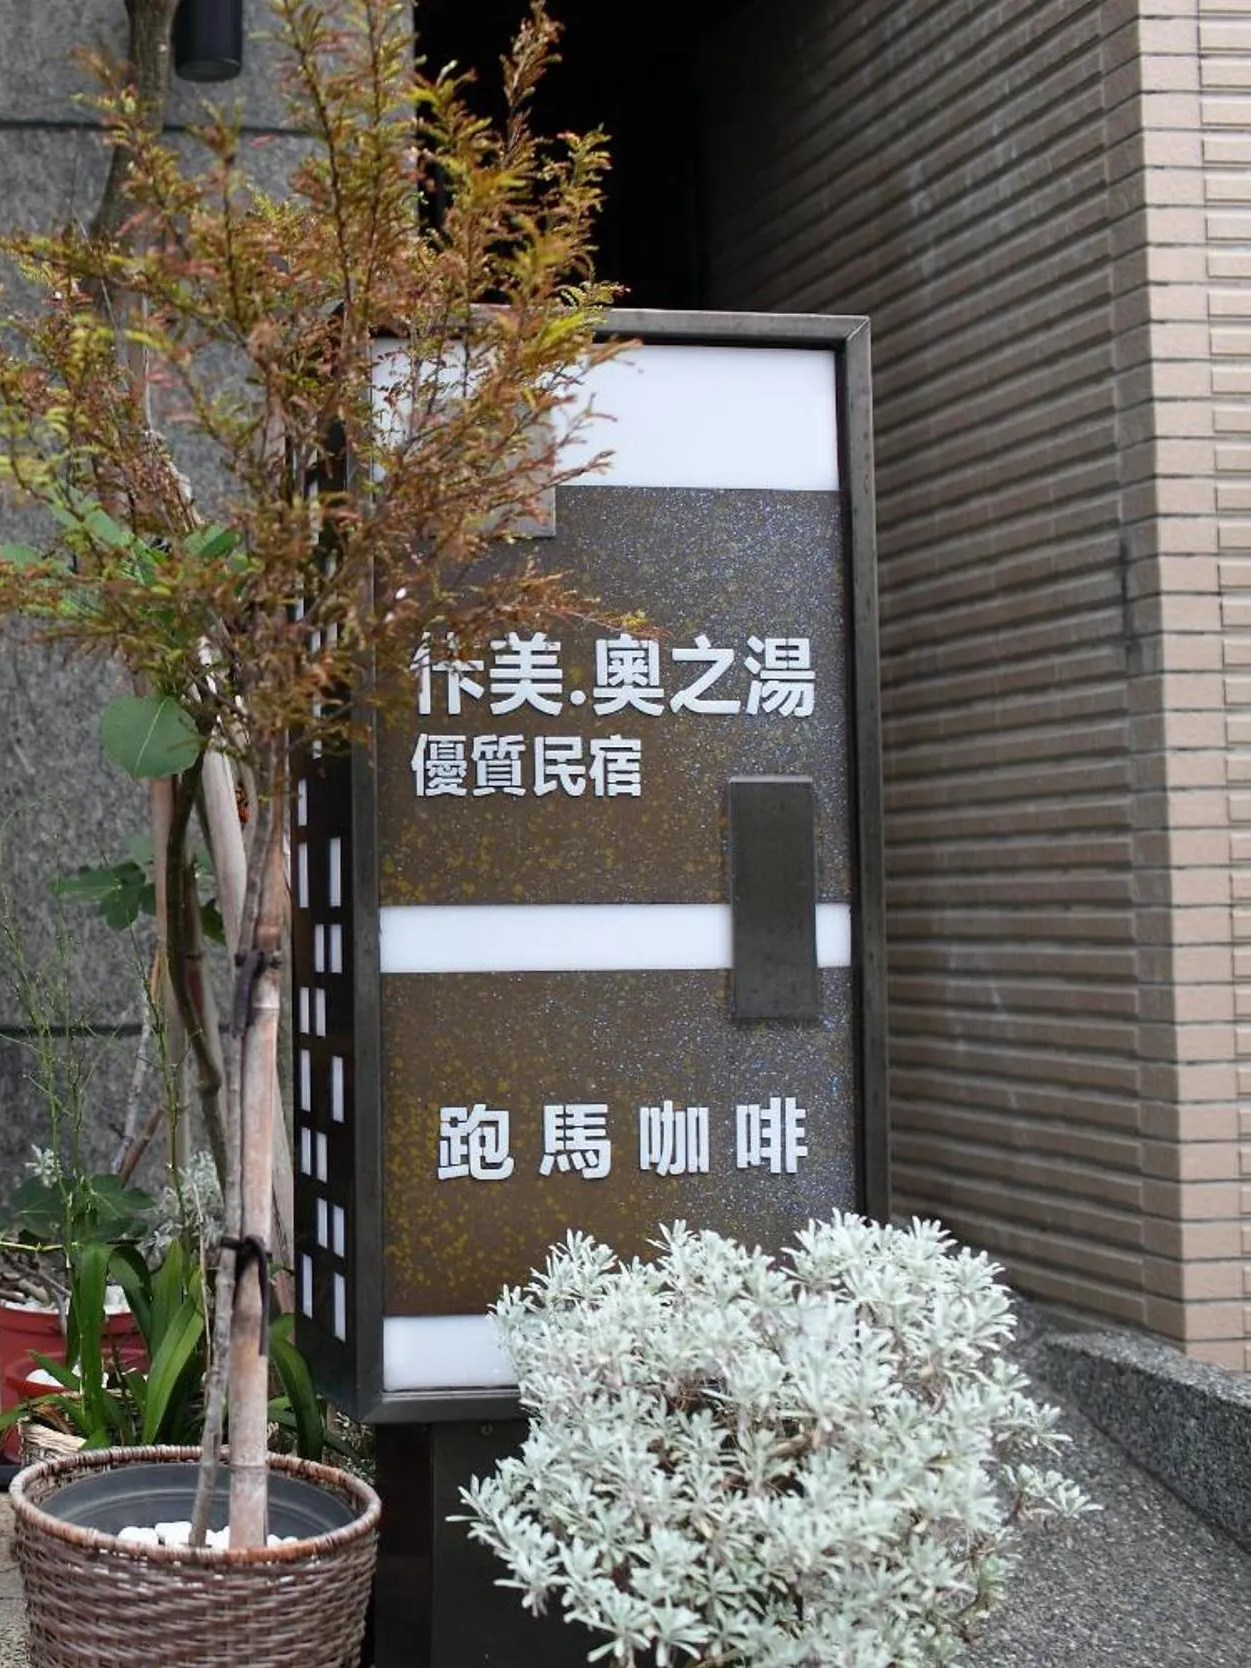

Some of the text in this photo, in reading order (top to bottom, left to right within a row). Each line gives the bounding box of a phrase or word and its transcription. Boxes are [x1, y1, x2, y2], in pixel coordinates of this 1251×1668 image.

[411, 733, 642, 797] 優質民宿
[438, 1098, 809, 1181] 跑馬咖啡
